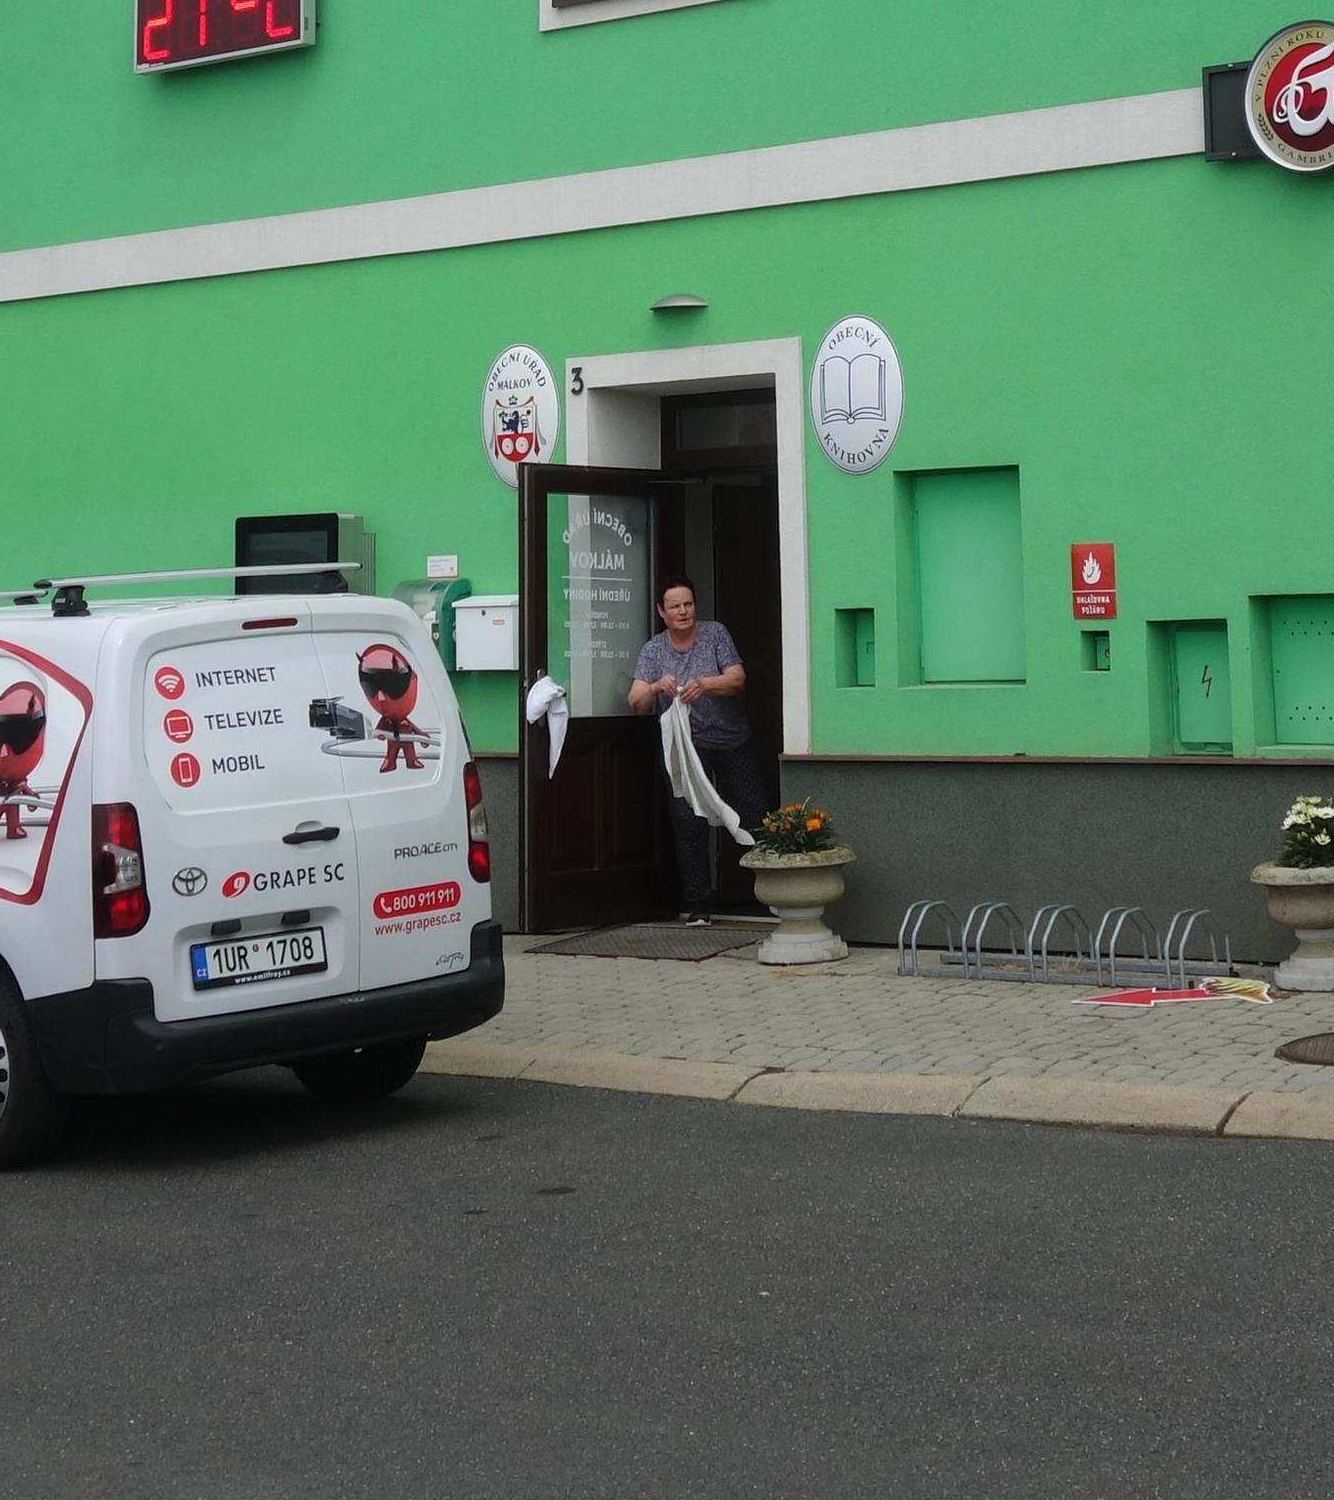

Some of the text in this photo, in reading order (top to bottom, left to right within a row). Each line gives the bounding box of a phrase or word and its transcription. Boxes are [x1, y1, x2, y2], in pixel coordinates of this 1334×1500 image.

[1287, 30, 1324, 46] ROKU
[828, 325, 881, 351] OBECNÍ
[523, 353, 547, 388] ÚŘAD
[570, 366, 584, 396] 3
[823, 427, 890, 465] KNIHOVNA
[195, 667, 275, 688] INTERNET
[204, 709, 284, 730] TELEVIZE
[212, 754, 265, 775] MOBIL
[394, 842, 441, 859] PROACE
[253, 867, 316, 891] GRAPE
[324, 863, 345, 882] SC
[393, 887, 455, 911] 800 911 911
[375, 912, 461, 936] www.grapesc.cz
[213, 936, 314, 974] 1UR 1708
[196, 968, 207, 978] CZ
